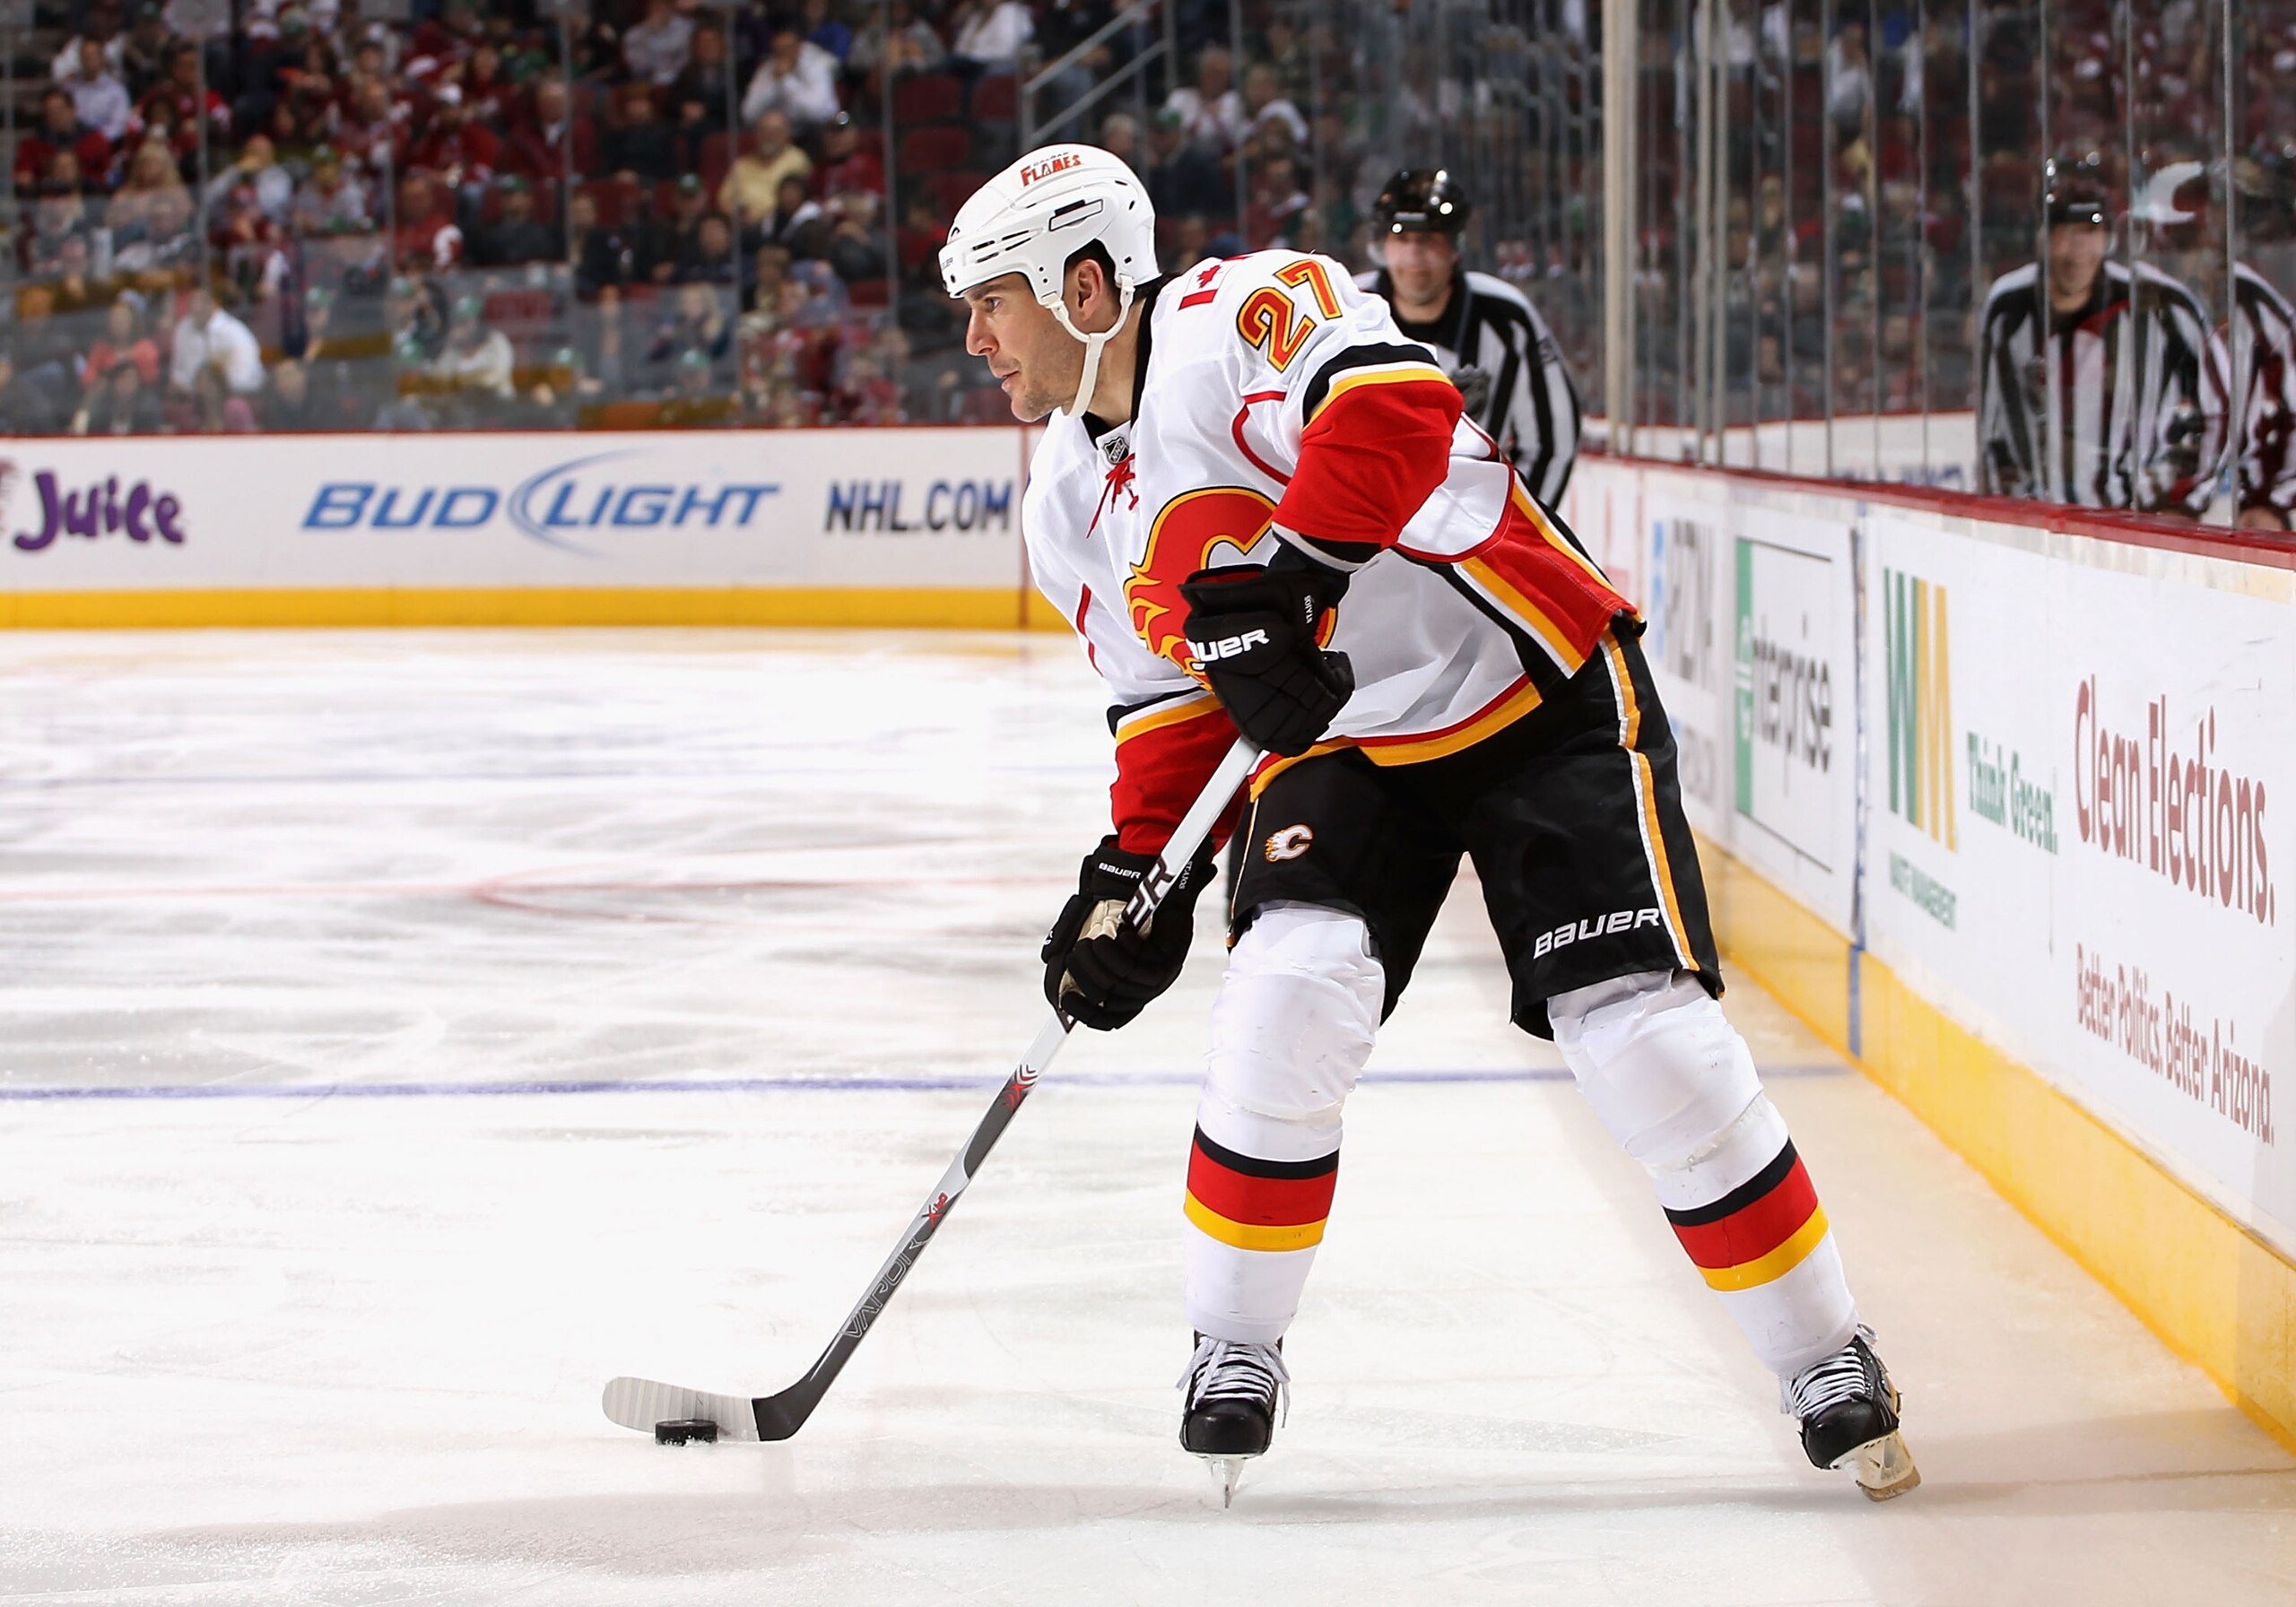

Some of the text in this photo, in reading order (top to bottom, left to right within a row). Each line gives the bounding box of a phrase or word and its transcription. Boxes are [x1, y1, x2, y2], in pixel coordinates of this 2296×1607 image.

[1020, 154, 1083, 187] FLAMES
[1237, 258, 1344, 372] 27
[13, 469, 187, 552] Juice
[301, 479, 783, 530] BUD LIGHT
[825, 479, 1014, 534] NHL.COM
[1185, 628, 1271, 663] UER
[1967, 730, 2006, 829] Think
[2074, 673, 2276, 928] Clean Elections.
[1098, 861, 1142, 880] BAUER
[1533, 908, 1660, 960] BAUER
[2076, 942, 2115, 1043] Better
[2165, 990, 2208, 1102] Better
[2211, 1017, 2274, 1148] Arizona.
